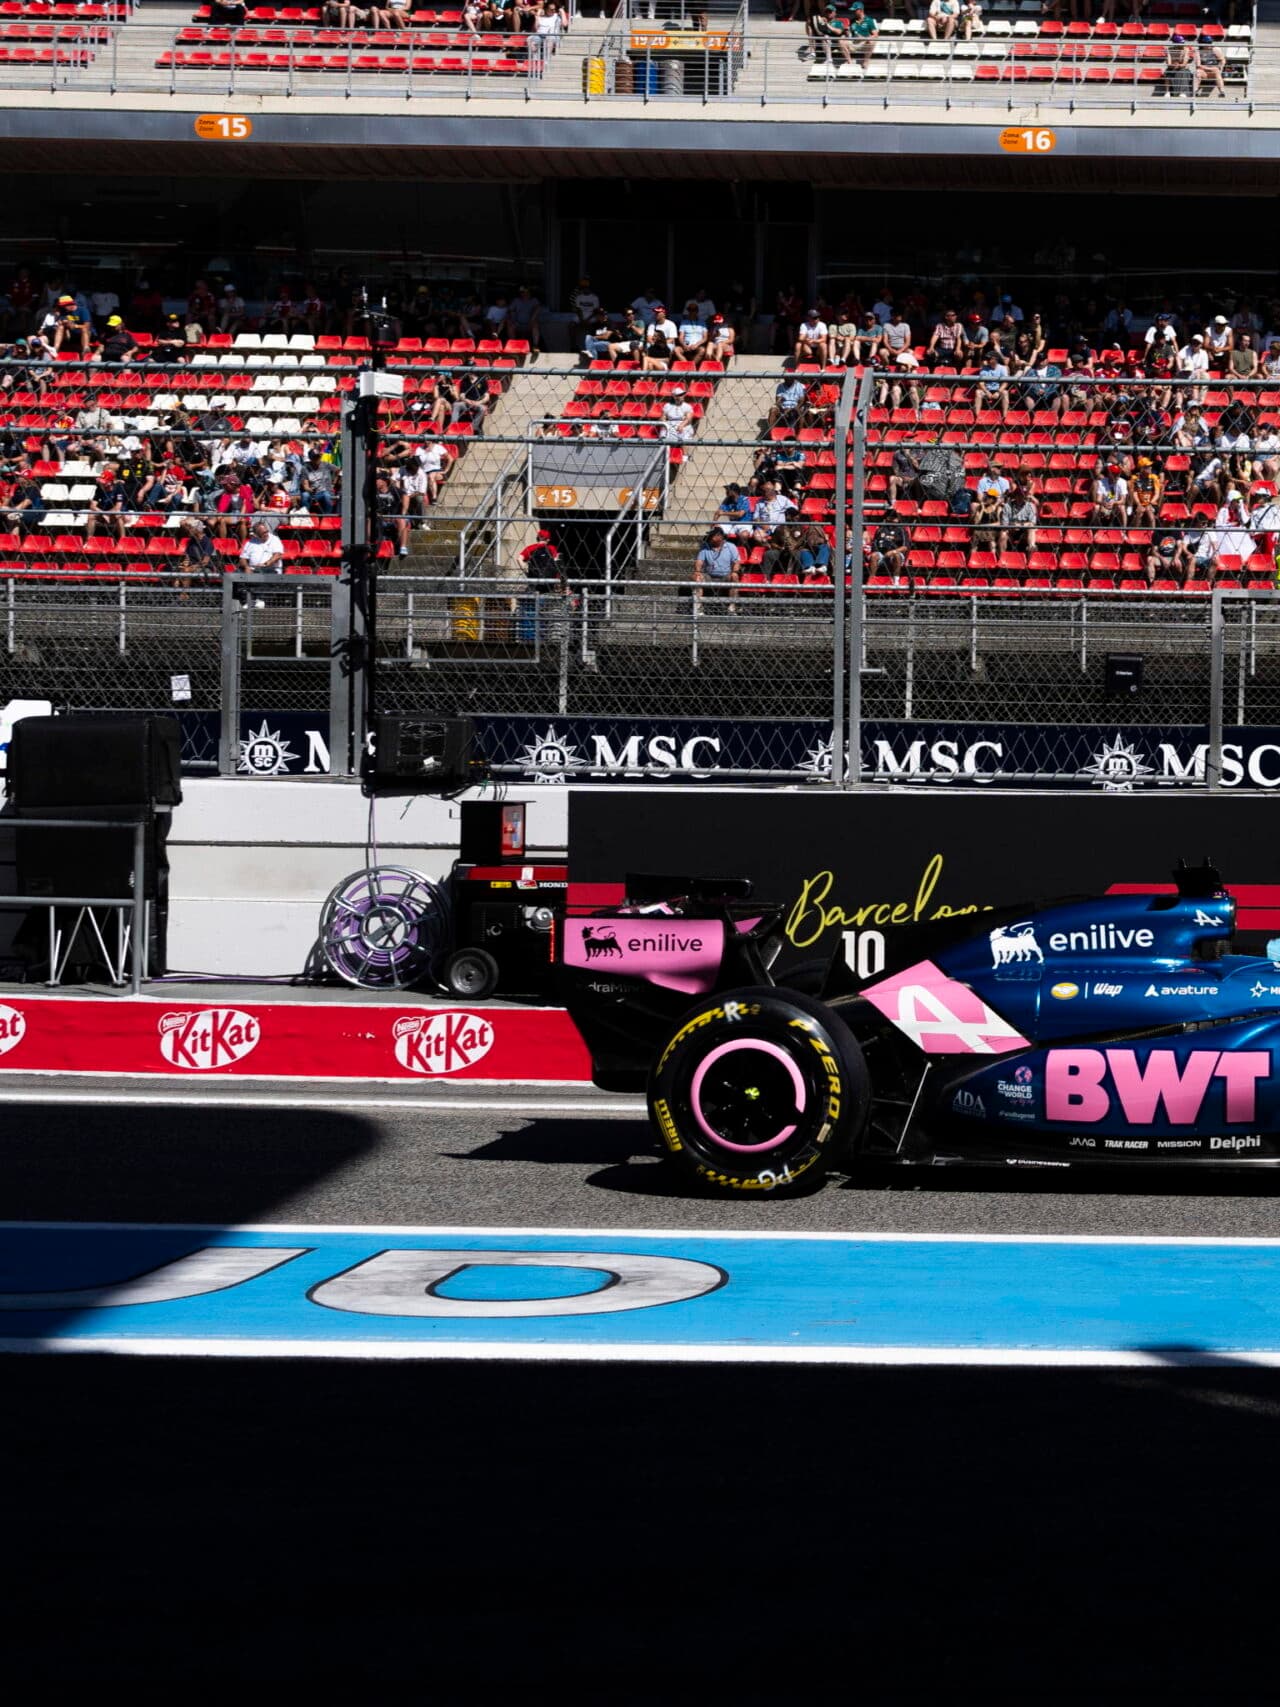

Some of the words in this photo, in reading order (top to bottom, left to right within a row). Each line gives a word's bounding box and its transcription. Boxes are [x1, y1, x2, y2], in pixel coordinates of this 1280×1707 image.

[218, 117, 247, 137] 15
[1021, 130, 1051, 150] 16
[550, 489, 572, 504] 15
[591, 735, 720, 778] MSC
[873, 740, 1003, 783] MSC
[628, 934, 703, 952] enilive
[1049, 923, 1155, 951] enilive
[842, 930, 885, 980] 10
[1093, 982, 1124, 997] Wap
[1161, 985, 1219, 995] avature
[171, 1010, 256, 1067] KitKat
[406, 1015, 490, 1072] KitKat
[809, 1038, 842, 1120] ZERO
[997, 1083, 1033, 1093] CHANGE
[1045, 1048, 1270, 1125] BWT
[953, 1089, 986, 1112] ADA
[1004, 1091, 1033, 1099] WORLD
[1104, 1139, 1123, 1148] TRAK
[1124, 1140, 1149, 1149] RACER
[1157, 1140, 1201, 1148] MISSION
[1210, 1135, 1261, 1151] Delphi
